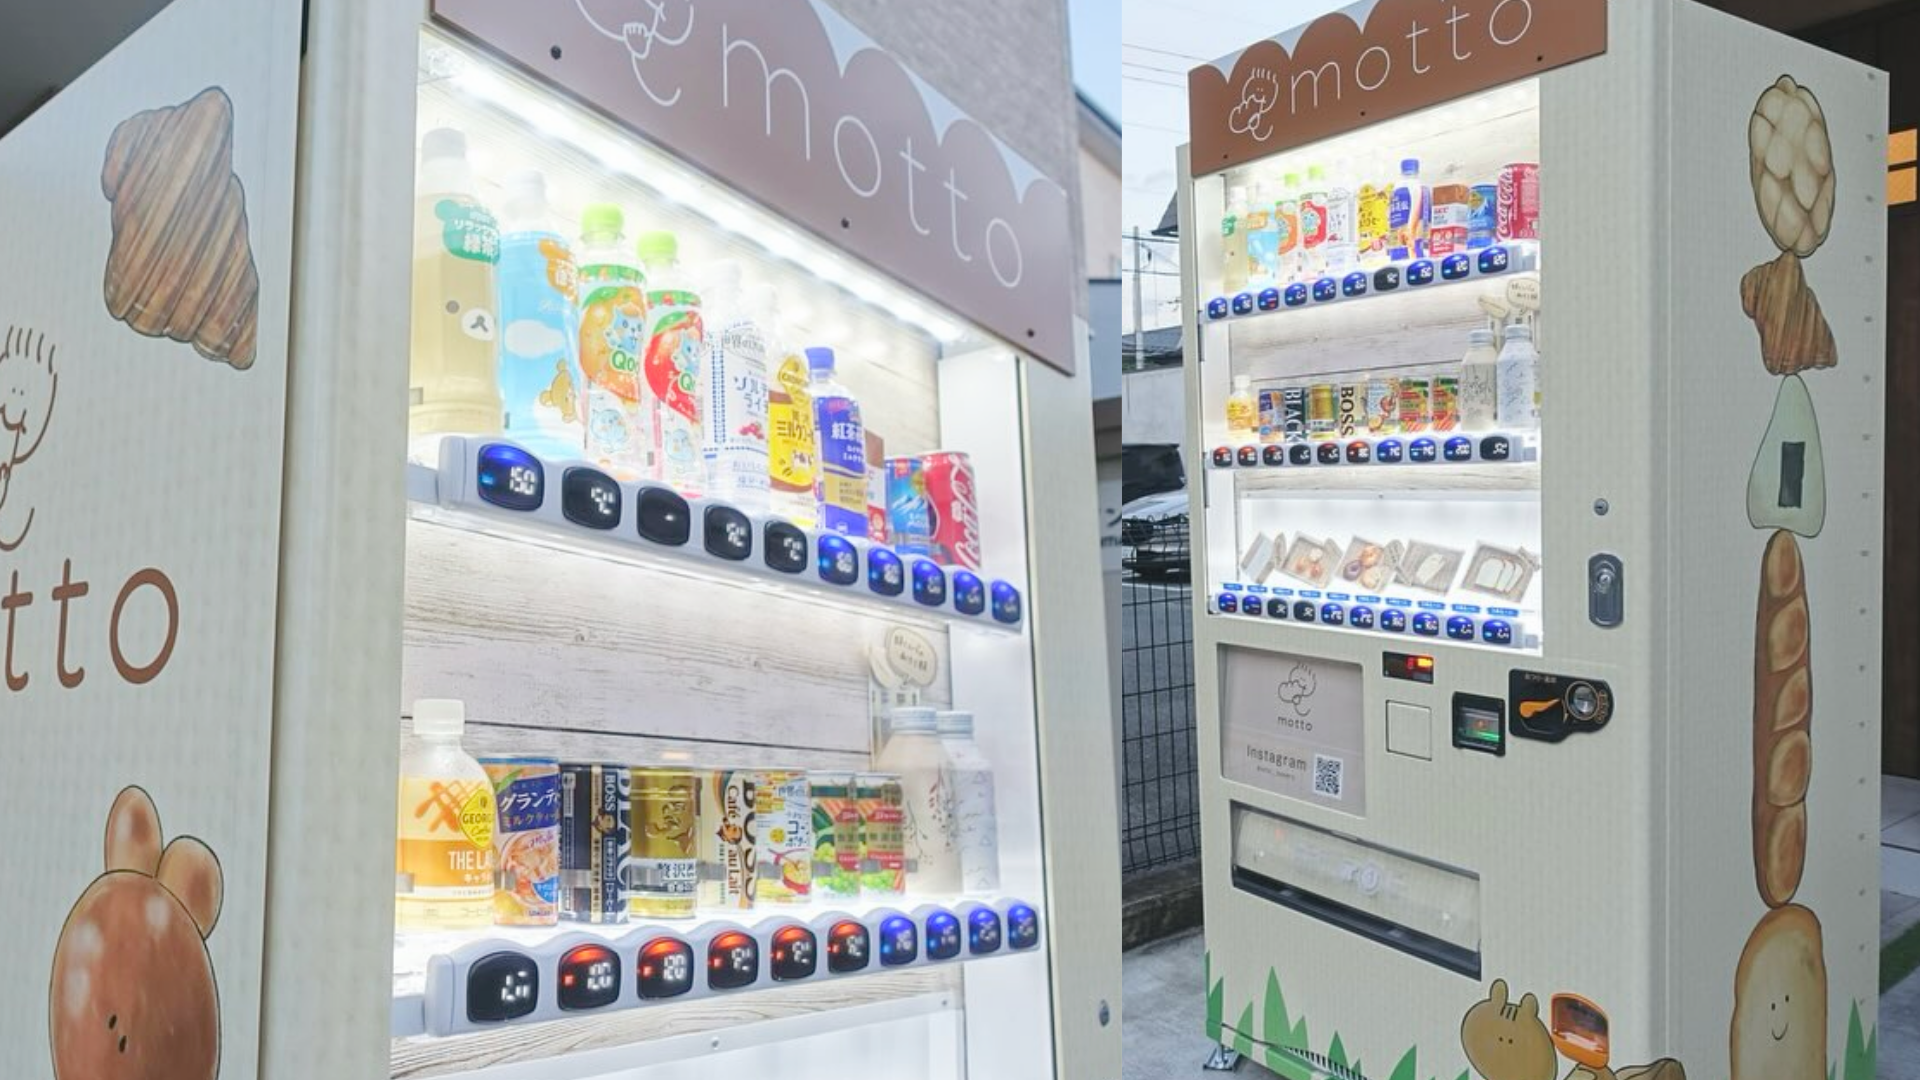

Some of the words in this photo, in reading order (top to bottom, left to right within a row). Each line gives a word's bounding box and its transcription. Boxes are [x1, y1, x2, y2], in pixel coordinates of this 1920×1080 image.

[1290, 0, 1532, 115] motto
[721, 22, 1022, 288] motto
[1340, 386, 1354, 437] BOSS
[1277, 716, 1313, 731] motto
[1247, 744, 1307, 772] Instagram
[604, 774, 616, 811] BOSS
[448, 851, 475, 870] THE
